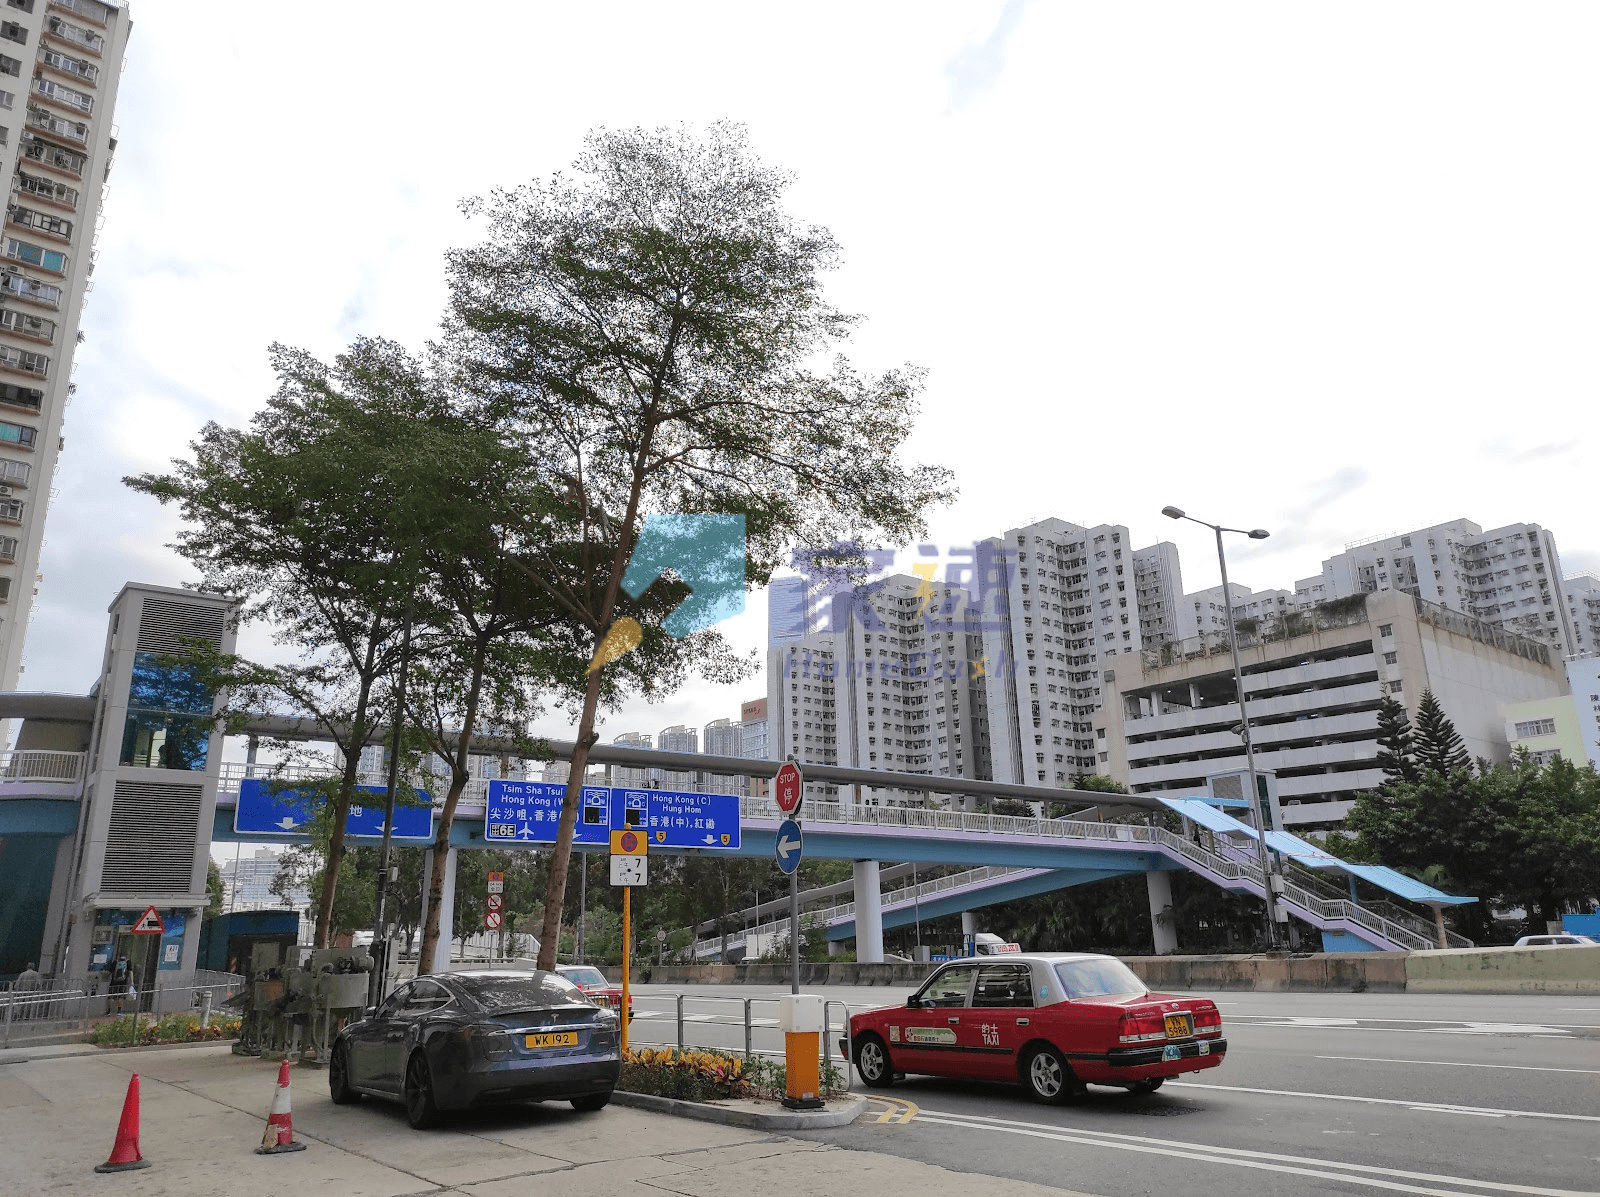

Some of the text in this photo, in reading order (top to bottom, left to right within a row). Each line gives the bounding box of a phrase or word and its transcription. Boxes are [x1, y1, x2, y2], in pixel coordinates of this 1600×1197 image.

[779, 772, 796, 784] STOP
[502, 784, 563, 796] Tsim Sha Tsui
[501, 795, 525, 806] Hong
[528, 796, 551, 807] Kong
[652, 794, 673, 804] Hong
[675, 795, 695, 806] Kong
[696, 796, 711, 806] (C)
[783, 787, 793, 805] 停
[662, 804, 702, 815] Hung Hom
[658, 832, 664, 841] 5
[723, 835, 728, 843] 5
[635, 858, 641, 868] 7
[635, 873, 641, 883] 7
[981, 1023, 999, 1035] 的士
[534, 1034, 570, 1045] WK 192
[982, 1034, 1000, 1045] TAXI
